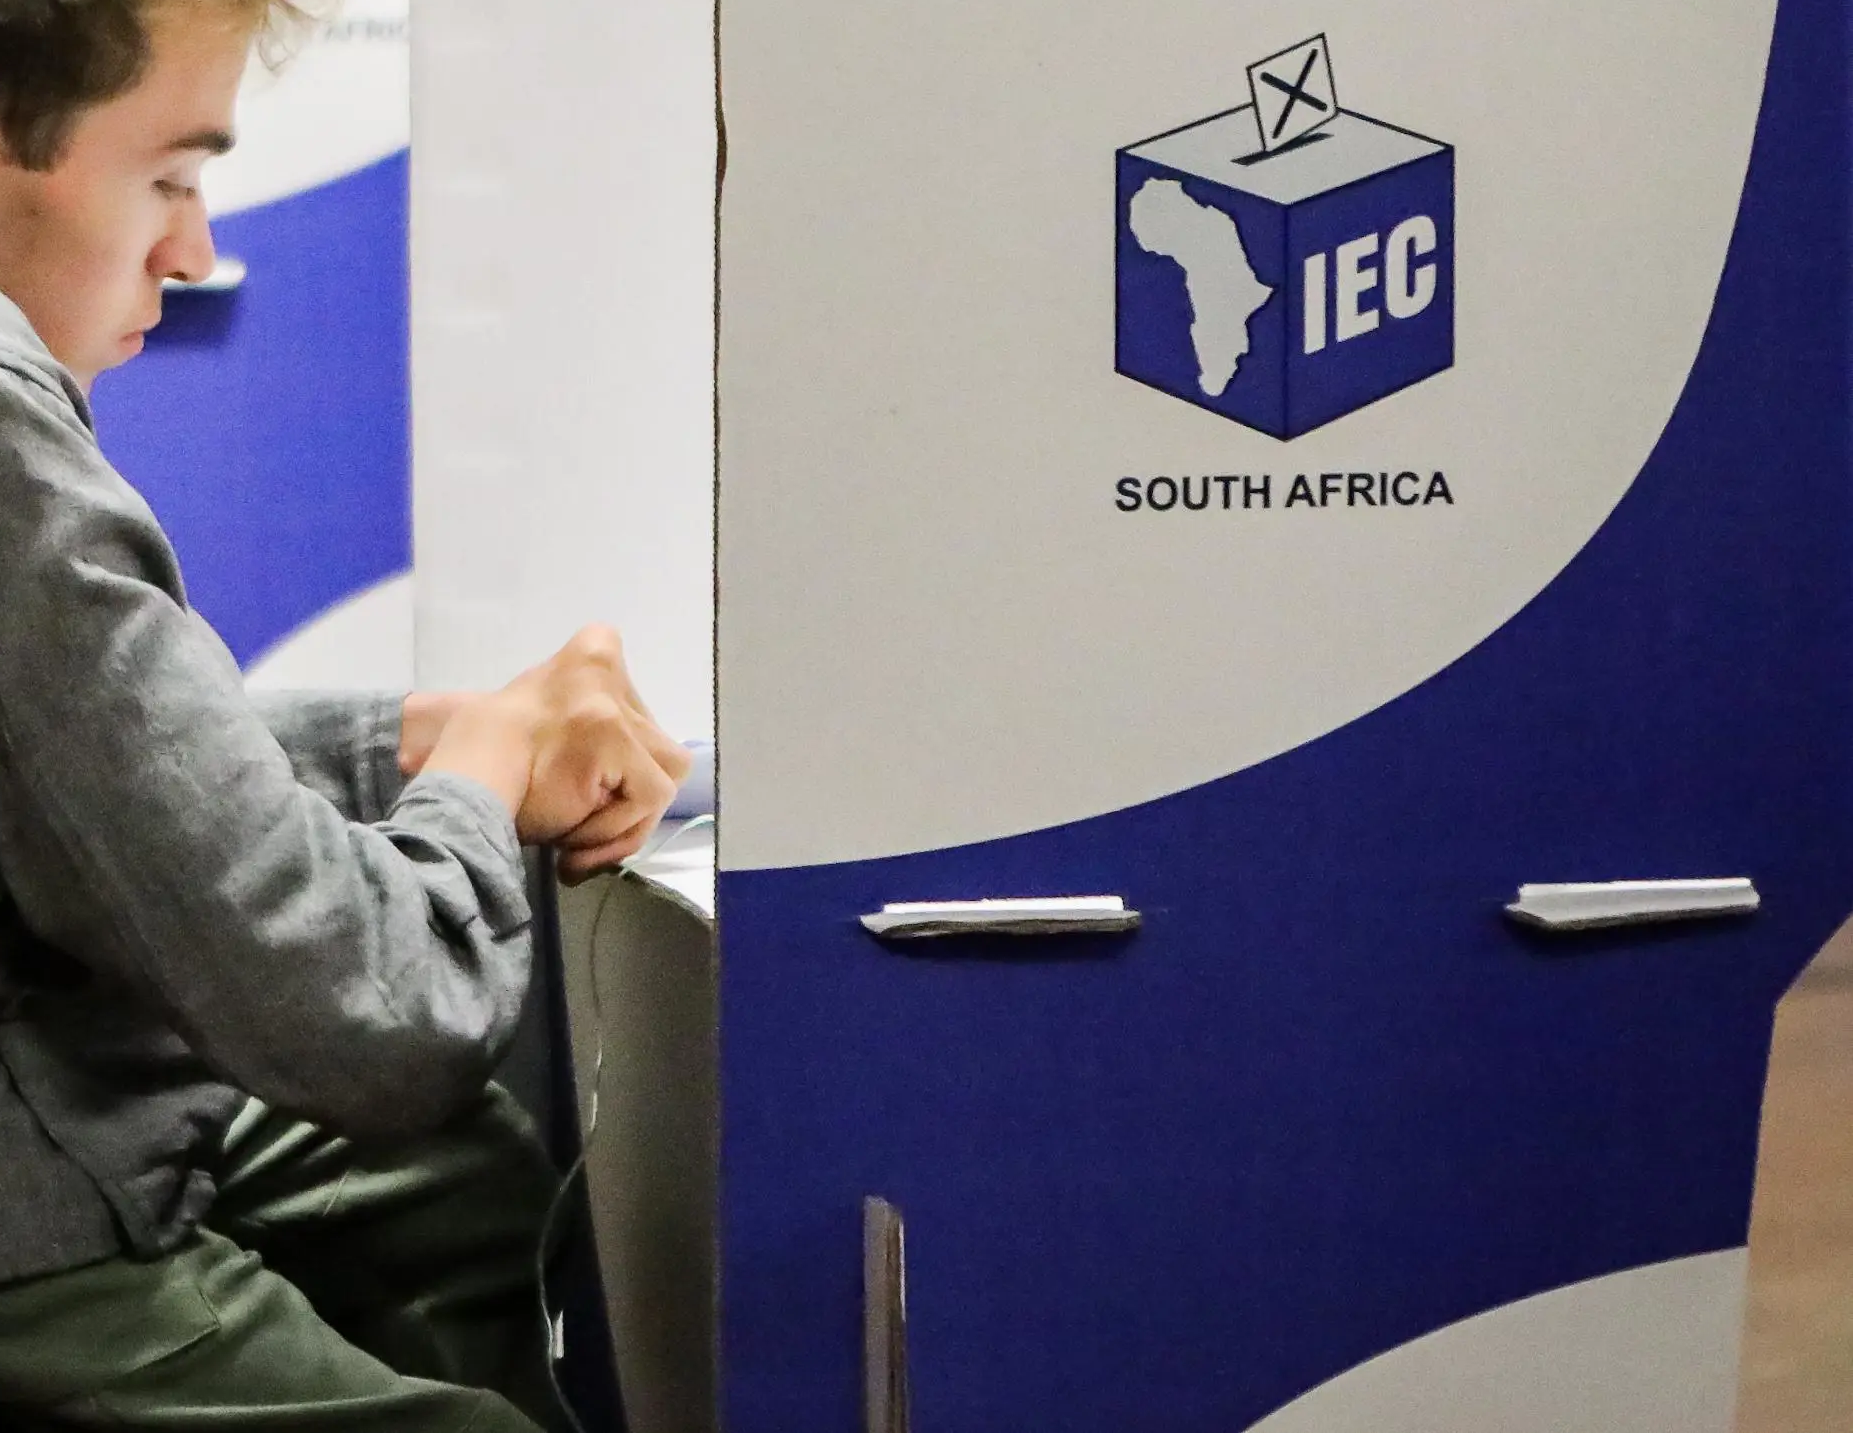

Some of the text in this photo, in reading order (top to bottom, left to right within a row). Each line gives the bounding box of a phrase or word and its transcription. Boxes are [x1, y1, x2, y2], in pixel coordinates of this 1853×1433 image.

[1303, 214, 1437, 355] IEC
[1114, 471, 1455, 512] SOUTH AFRICA
